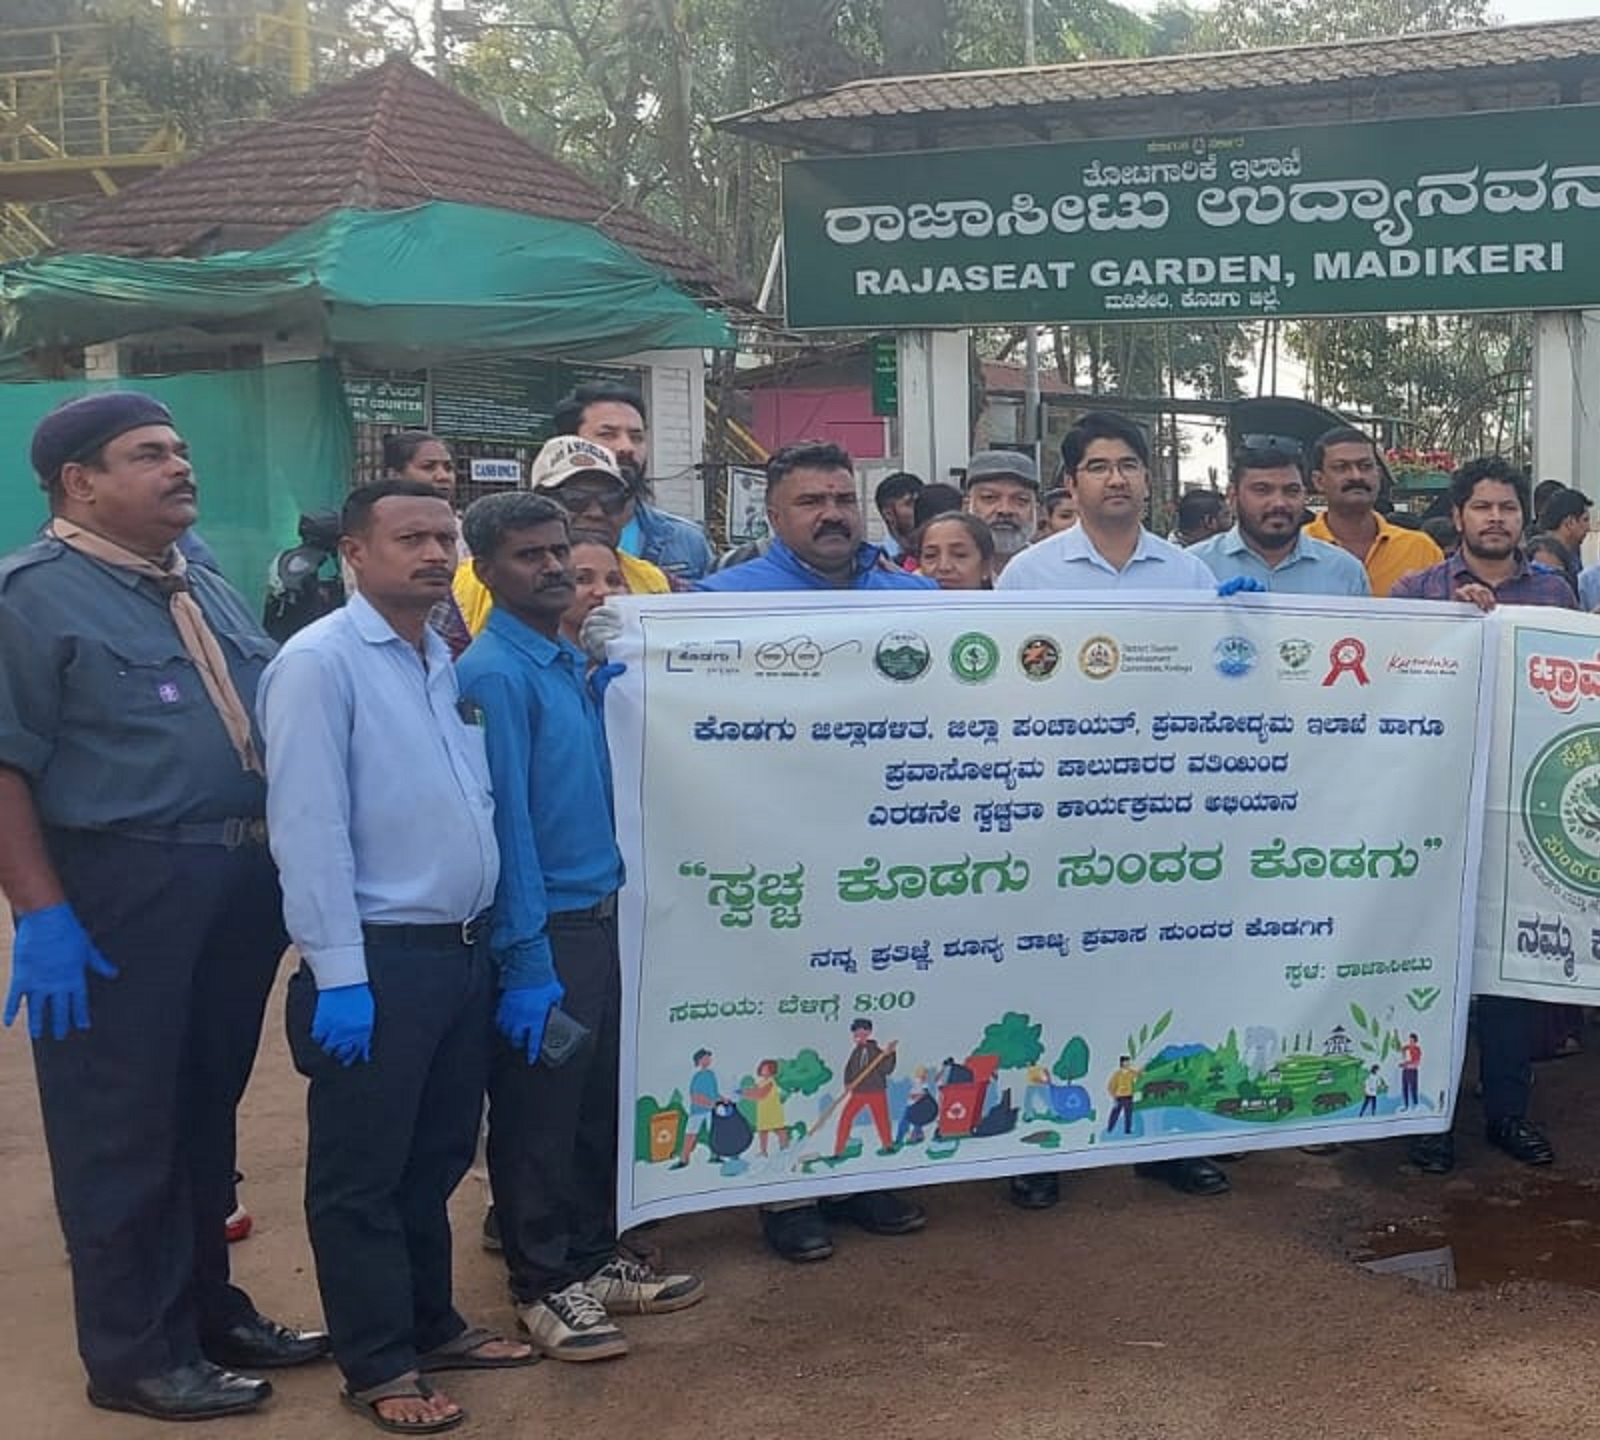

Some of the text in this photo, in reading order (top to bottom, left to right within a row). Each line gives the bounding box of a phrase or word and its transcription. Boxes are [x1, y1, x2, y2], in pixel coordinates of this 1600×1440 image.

[1083, 147, 1301, 187] ತೋಟಗಾರಿಕೆ ಇಲಾಖೆ
[824, 191, 1169, 244] ರಾಜಾಸೀಟು
[855, 242, 1563, 295] RAJASEAT GARDEN, MADIKERI
[1181, 288, 1241, 307] ಕೊಡಗು
[370, 399, 422, 411] COUNTER
[694, 715, 797, 741] ಕೊಡಗು
[947, 714, 1000, 745] ಜಿಲ್ಲಾ
[1151, 710, 1295, 744] ಪ್ರವಾಸೋದ್ಯಮ
[1307, 711, 1367, 738] ಇಲಾಖೆ
[1378, 712, 1445, 737] ಹಾಗೂ
[885, 751, 1289, 790] ಪ್ರವಾಸೋದ್ಯಮ ಪಾಲುದಾರರ ವತಿಯಿಂದ
[868, 799, 961, 826] ಎರಡನೇ
[1057, 792, 1193, 821] ಕಾರ್ಯಕ್ರಮದ
[1204, 790, 1299, 815] ಅಭಿಯಾನ
[838, 850, 1031, 903] ಕೊಡಗು
[1057, 841, 1224, 888] ಸುಂದರ
[1250, 837, 1442, 881] ಕೊಡಗು”
[810, 948, 858, 973] ನನ್ನ
[943, 934, 1005, 963] ಶೂನ್ಯ
[1082, 923, 1148, 952] ಪ್ರವಾಸ
[1159, 920, 1234, 943] ಸುಂದರ
[1245, 917, 1334, 938] ಕೊಡಗಿಗೆ
[1517, 913, 1575, 976] ನಮ್ಮ
[669, 999, 764, 1023] ಸಮಯ:
[853, 990, 916, 1012] 8:00
